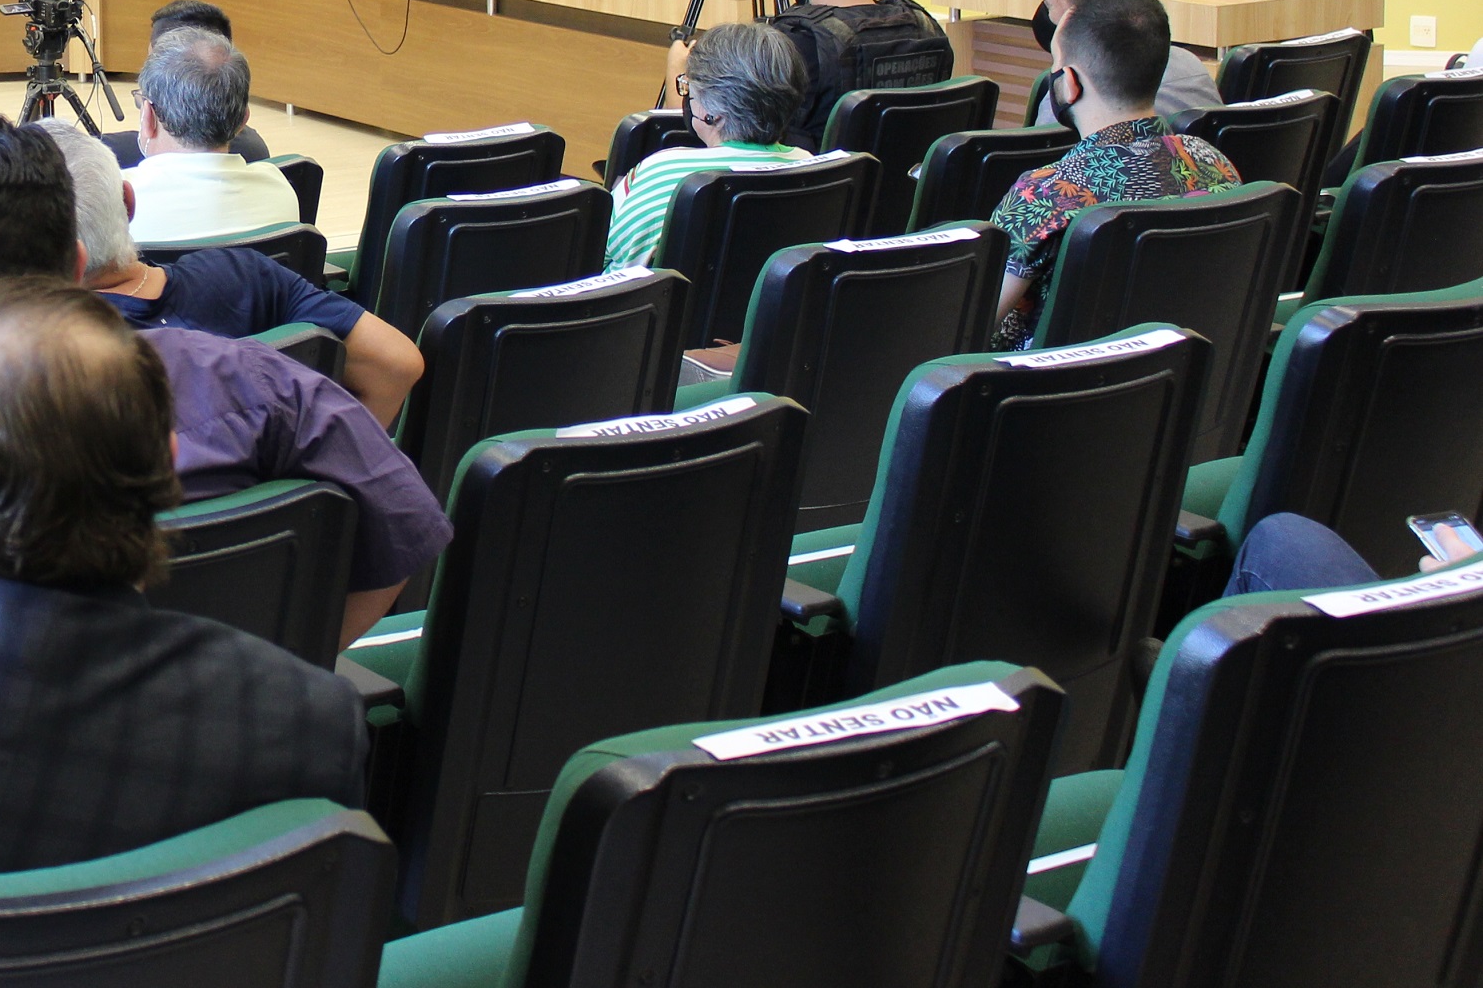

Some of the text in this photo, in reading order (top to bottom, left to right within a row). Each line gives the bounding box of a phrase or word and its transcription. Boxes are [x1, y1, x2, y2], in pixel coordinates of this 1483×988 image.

[876, 55, 937, 76] OPERAÇÕES
[854, 238, 914, 249] SENTAR
[1030, 349, 1105, 363] SENTAR
[1357, 579, 1458, 602] SENTAR
[754, 696, 960, 744] NÃO SENTAR
